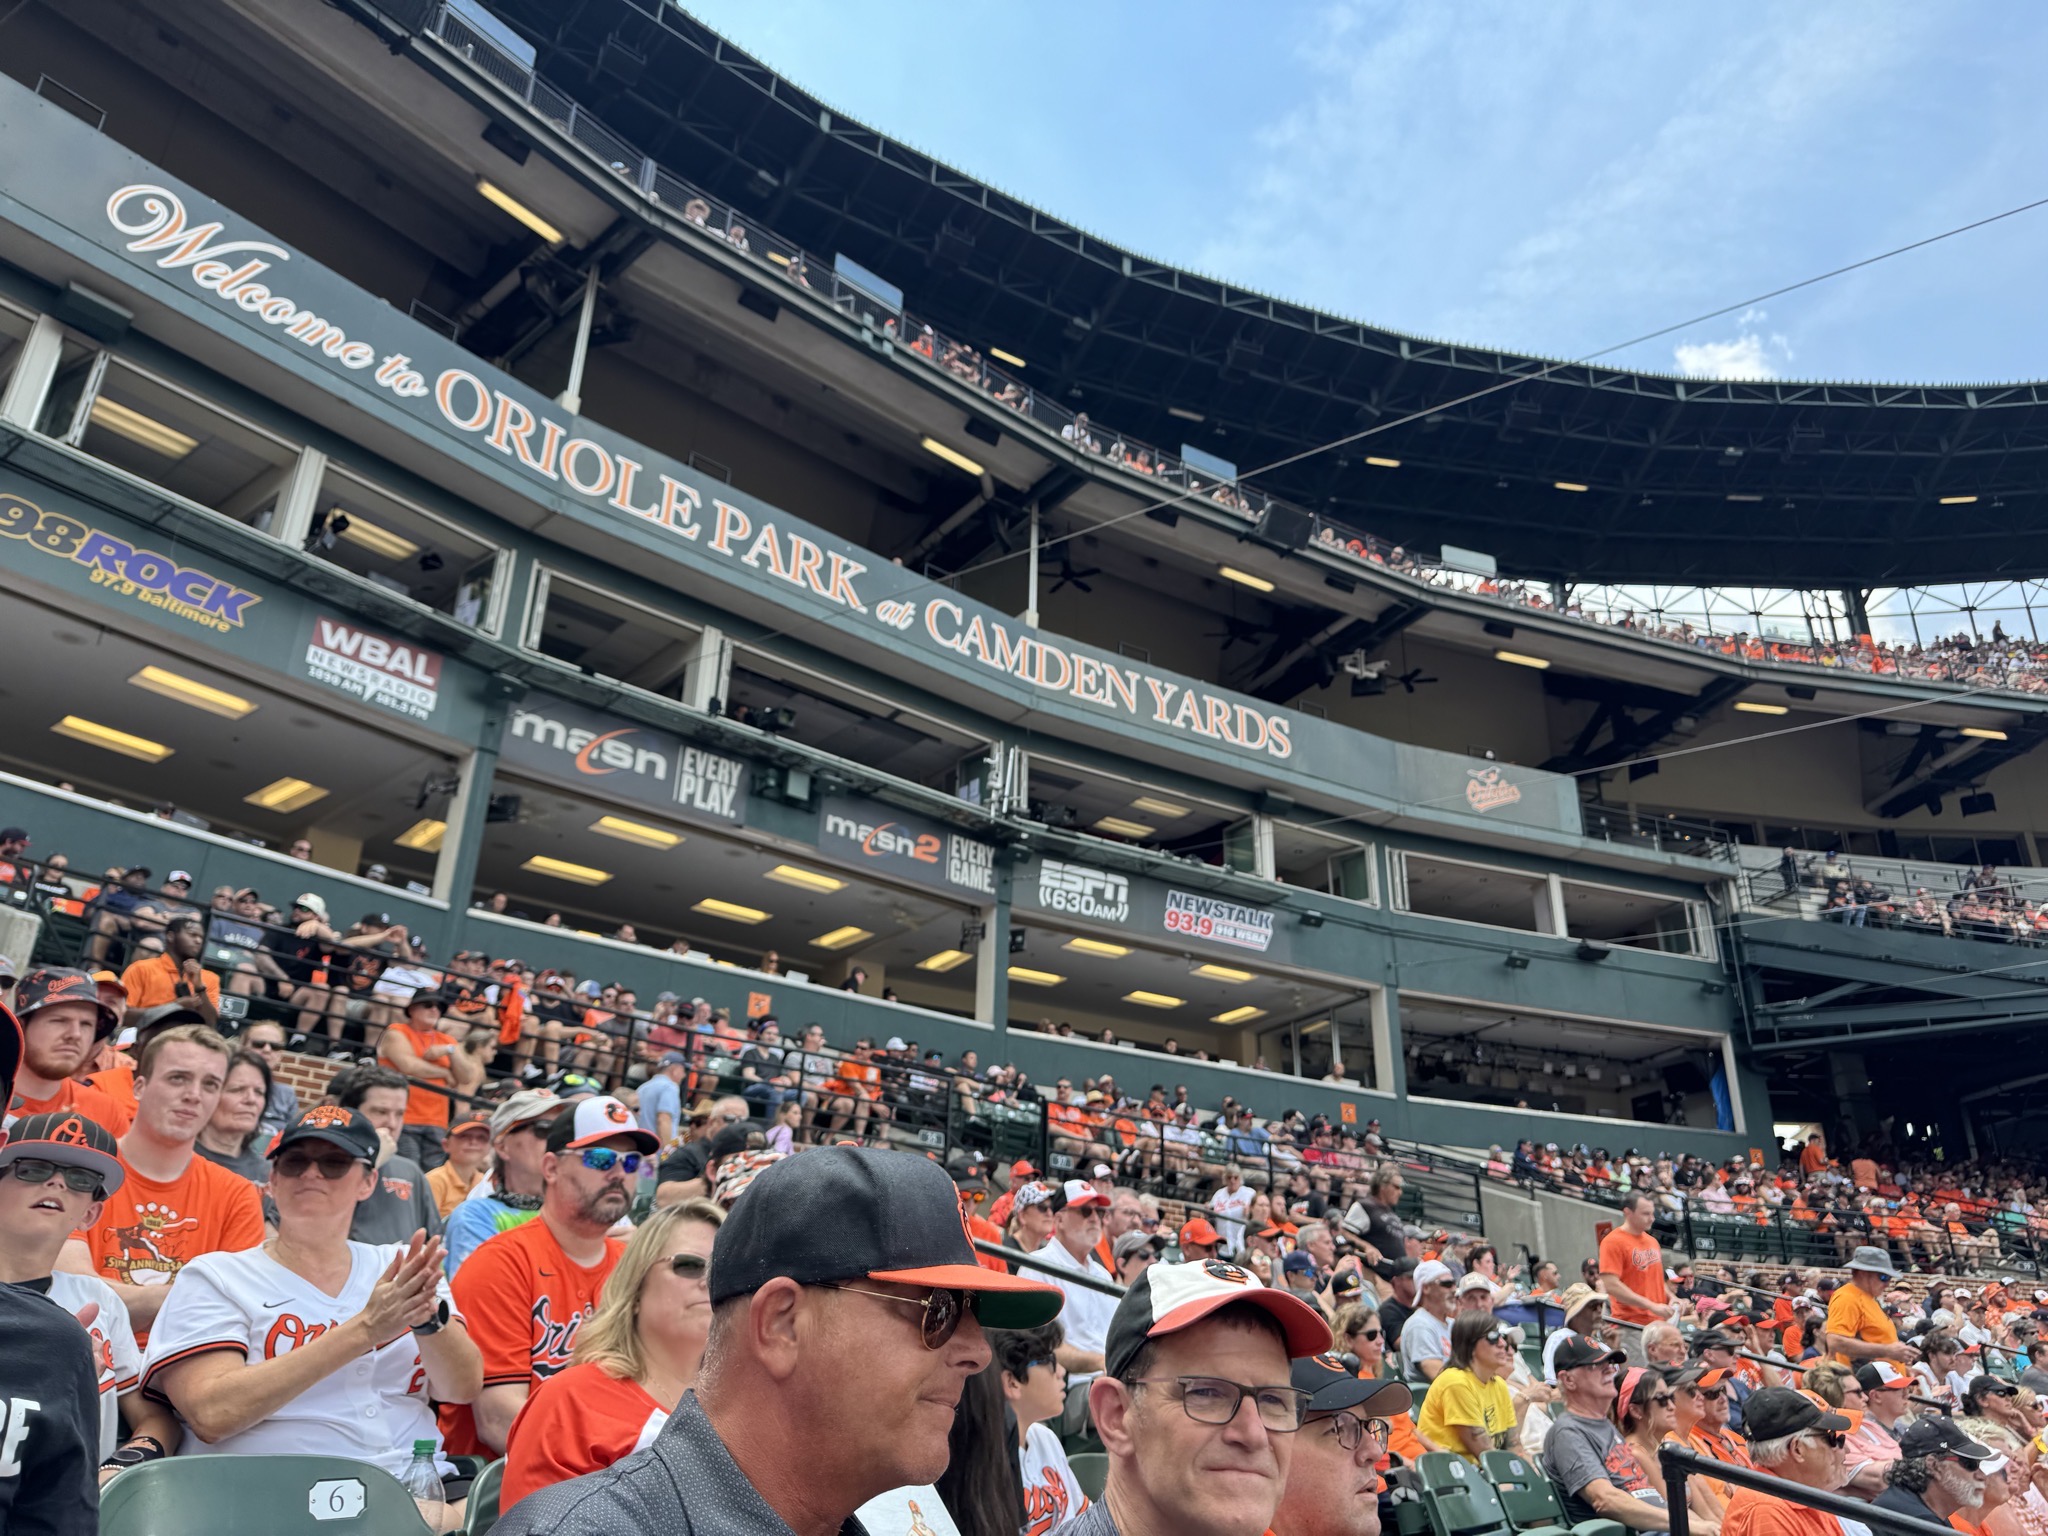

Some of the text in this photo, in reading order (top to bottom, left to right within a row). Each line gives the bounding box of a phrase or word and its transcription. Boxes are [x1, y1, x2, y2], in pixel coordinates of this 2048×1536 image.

[106, 184, 1292, 759] Welcome to ORIOLE PARK at CAMDEN YARDS
[90, 568, 231, 633] 97.9 baltimore
[321, 620, 435, 687] WBAL
[311, 650, 433, 706] NEWSRADIO
[341, 680, 364, 696] AM
[409, 705, 429, 720] FM
[682, 746, 743, 788] EVERY
[679, 775, 736, 819] PLAY.
[952, 834, 996, 868] EVERY
[950, 858, 996, 895] GAME.
[1039, 858, 1129, 903] ESPN
[1166, 909, 1213, 936] 93.9
[1168, 892, 1272, 930] NEWSTALK
[129, 1259, 183, 1273] ANNIVERSA
[329, 1485, 345, 1513] 6
